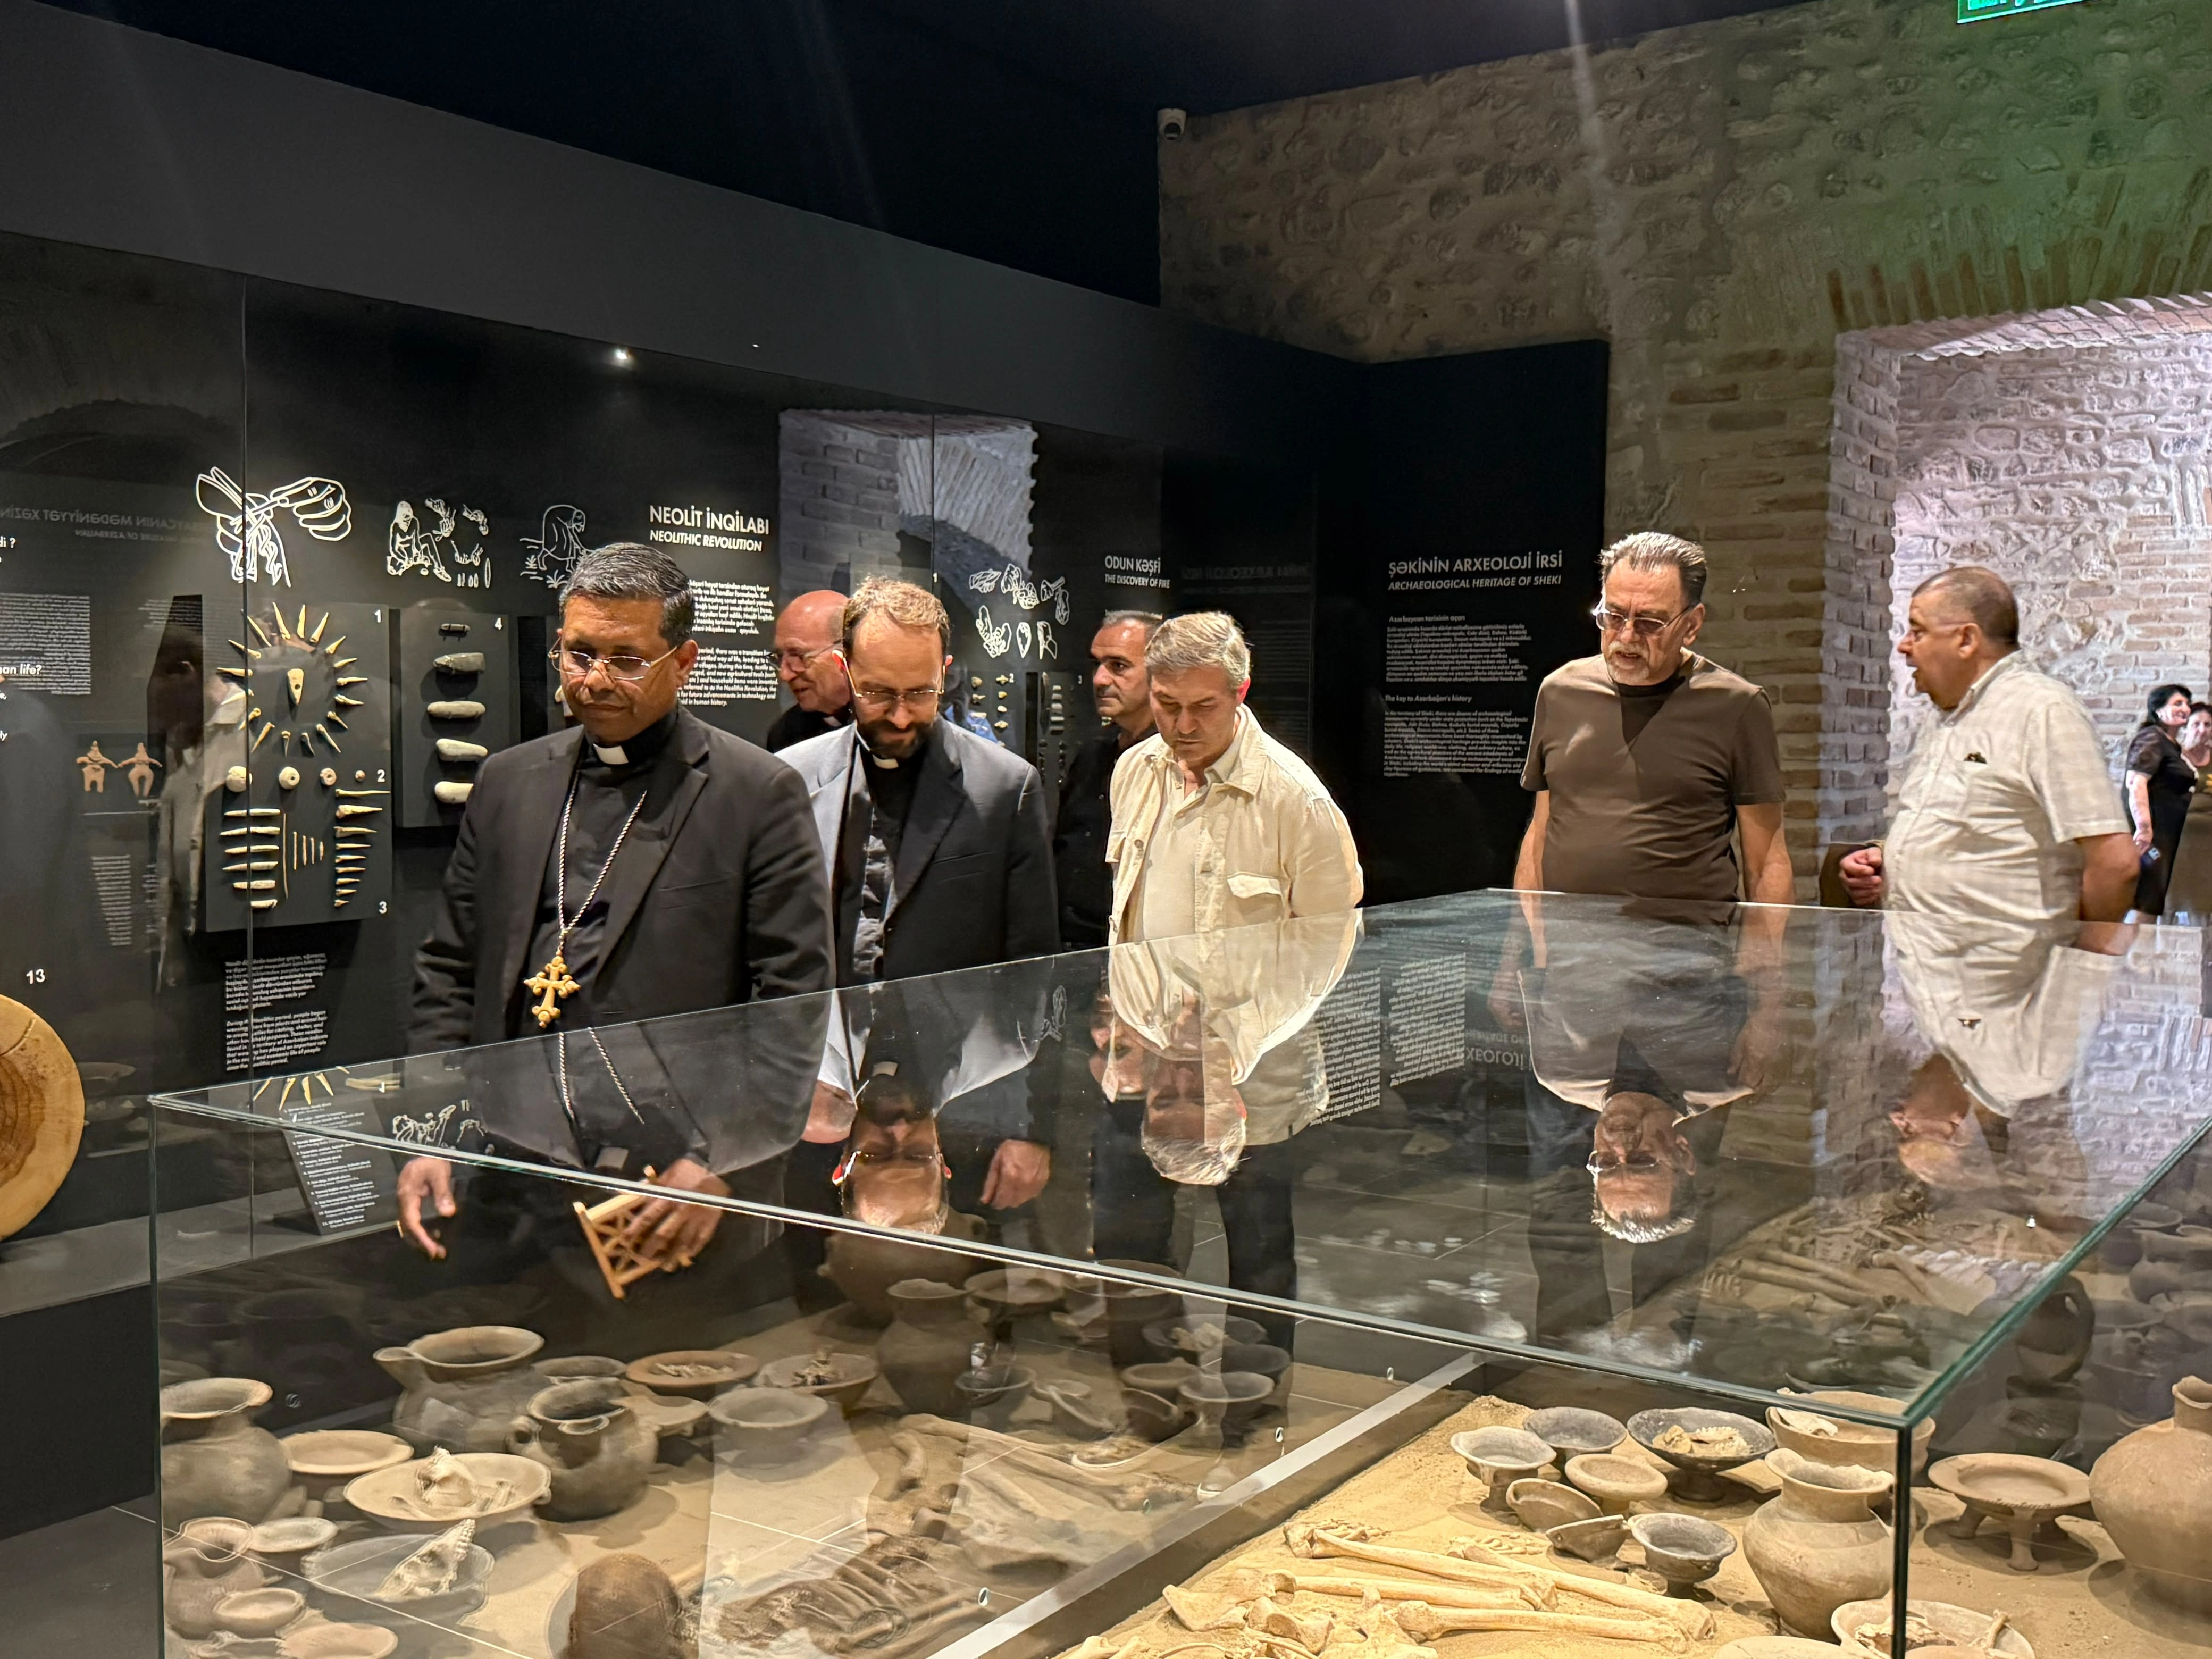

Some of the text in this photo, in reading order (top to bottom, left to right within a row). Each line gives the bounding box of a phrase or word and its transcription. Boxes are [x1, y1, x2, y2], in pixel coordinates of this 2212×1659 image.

[650, 505, 769, 535] NEOLİT İNQİLABI
[650, 530, 762, 552] NEOLITHIC REVOLUTION
[1105, 555, 1134, 571] ODUN
[1388, 550, 1562, 579] ŞƏKİNİN ARXEOLOJİ İRSİ
[1105, 574, 1170, 589] THE DISCOVERY OF FIRE
[1387, 575, 1561, 591] ARCHAEOLOGICAL HERITAGE OF SHEKI
[374, 610, 382, 623] 1
[494, 617, 502, 629] 4
[376, 770, 386, 782] 2
[379, 901, 387, 914] 3
[26, 969, 45, 984] 13
